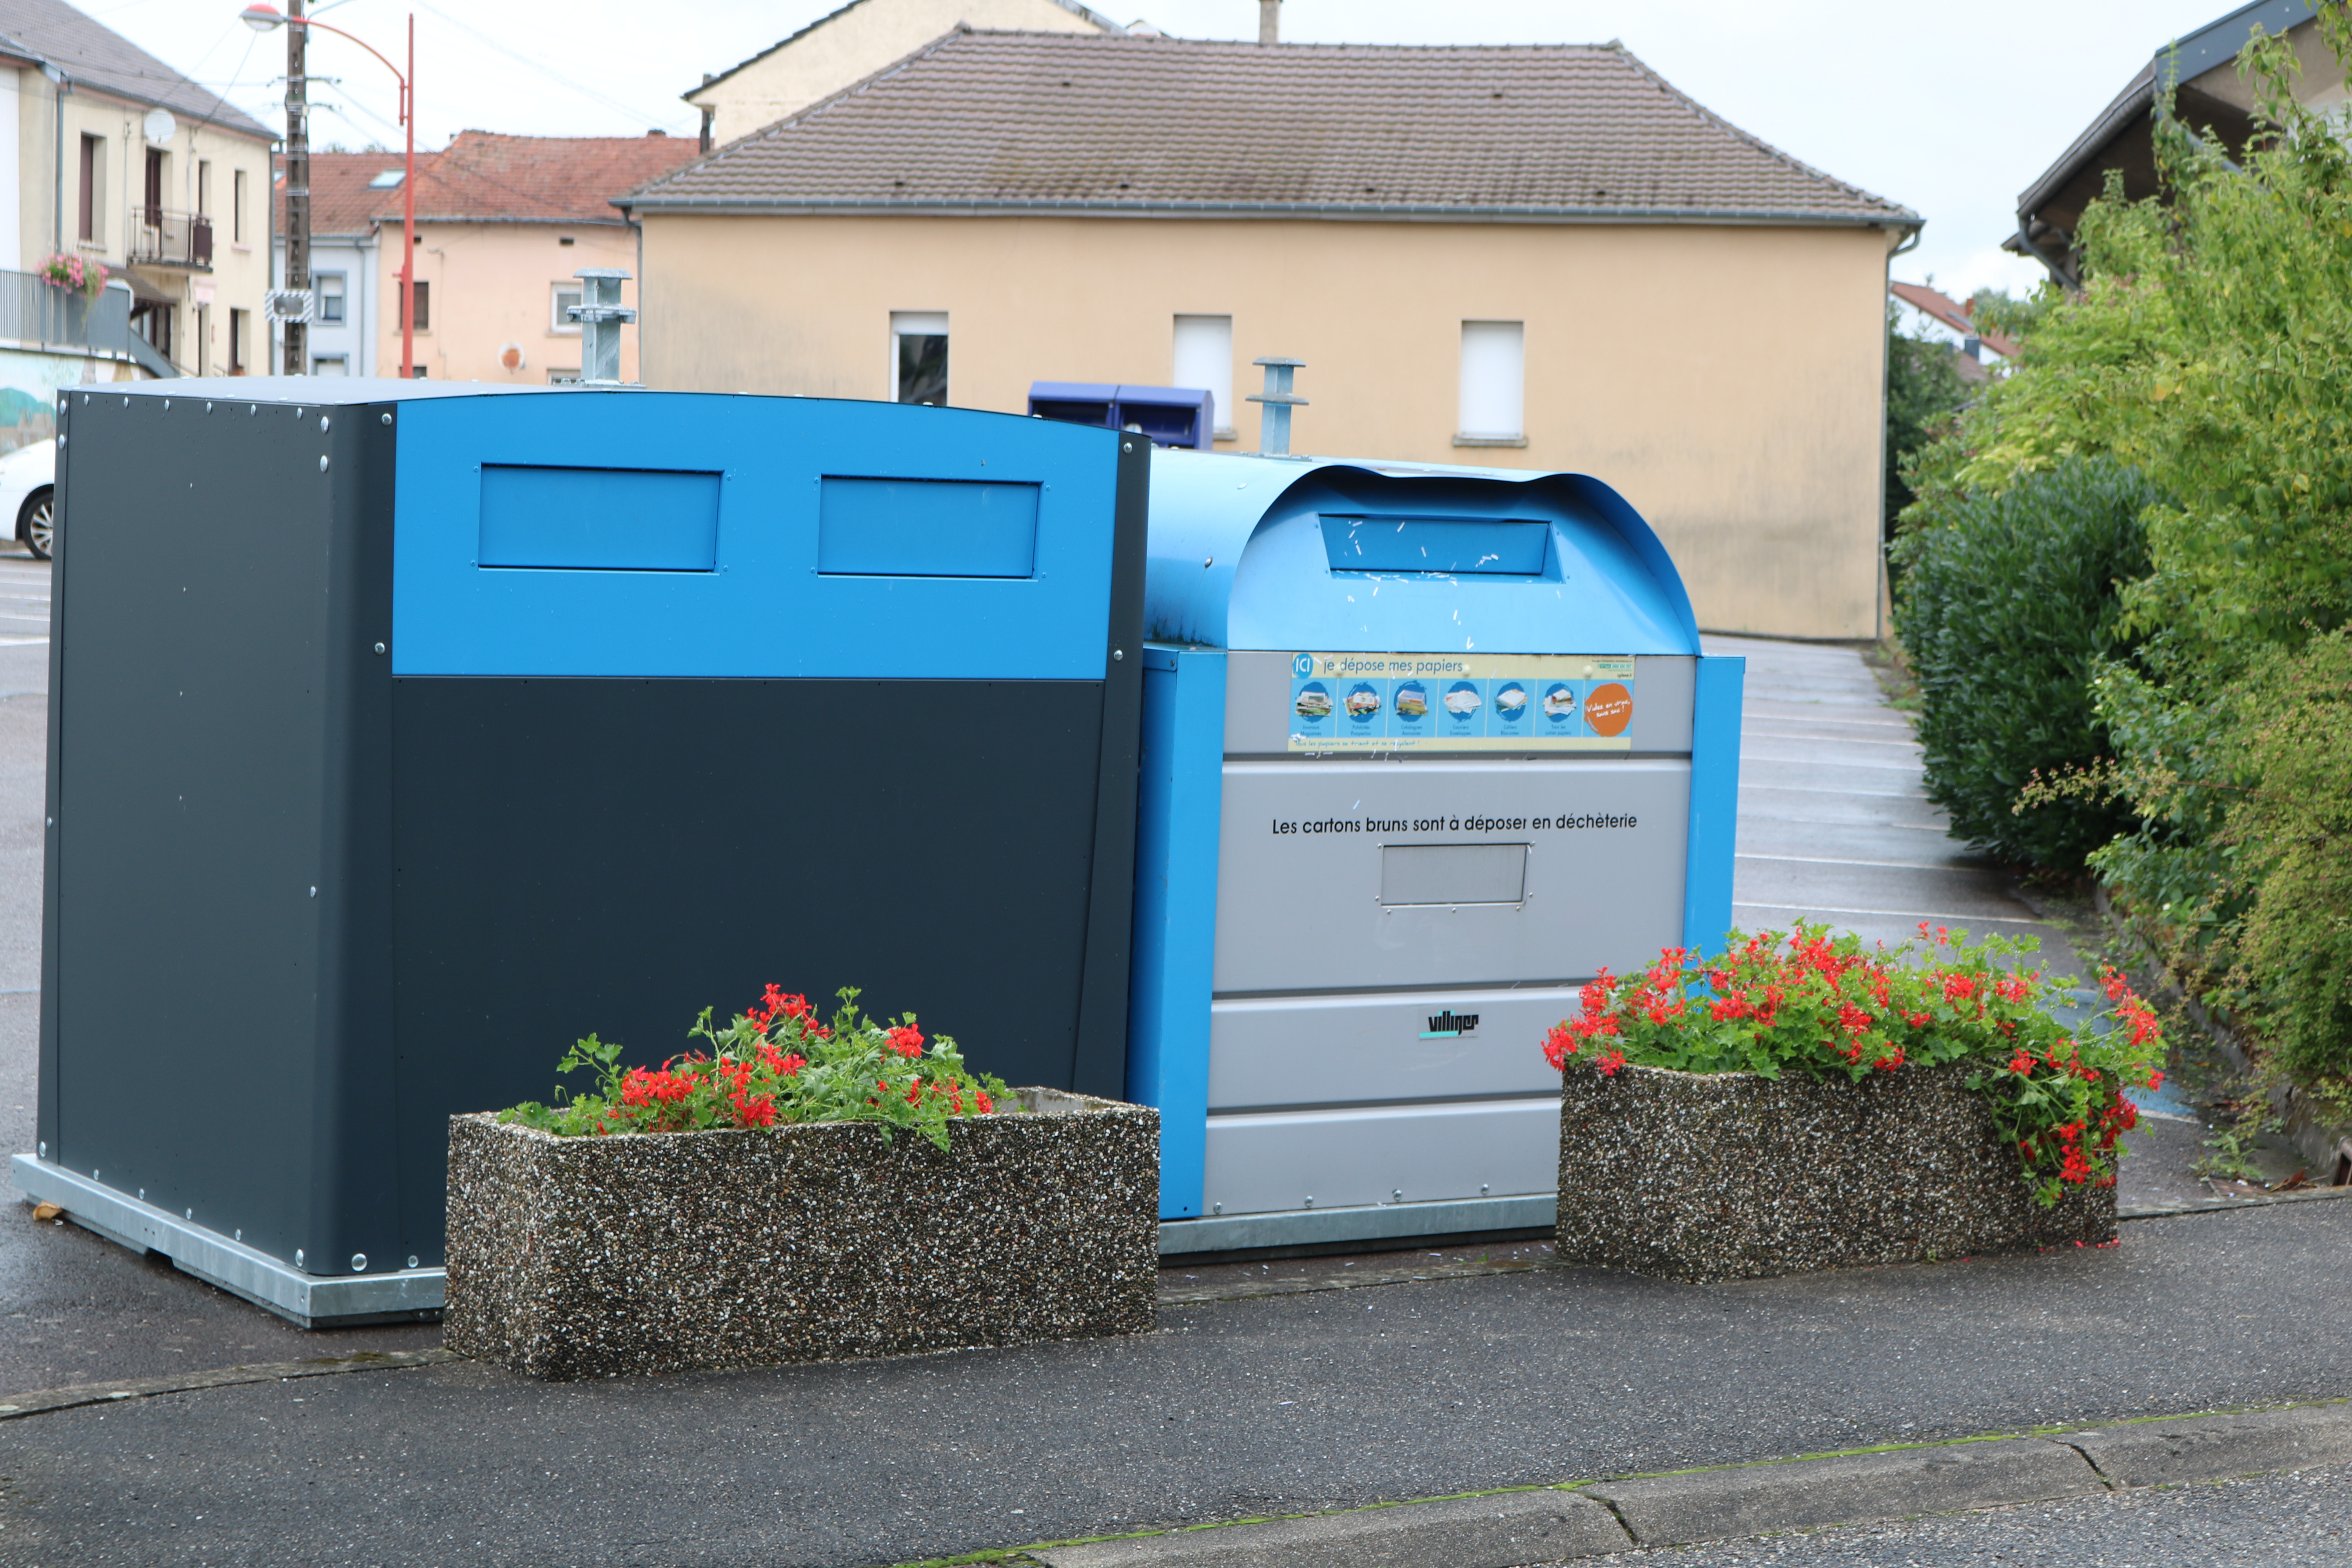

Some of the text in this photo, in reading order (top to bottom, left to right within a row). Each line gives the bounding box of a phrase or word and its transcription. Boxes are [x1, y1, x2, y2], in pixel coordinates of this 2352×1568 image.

[1296, 658, 1463, 674] ICI je dépose mes papiers
[1587, 703, 1603, 712] Videz
[1273, 813, 1637, 834] Les cartons bruns sont à déposer en déchèterie
[1428, 1010, 1479, 1036] villiger
